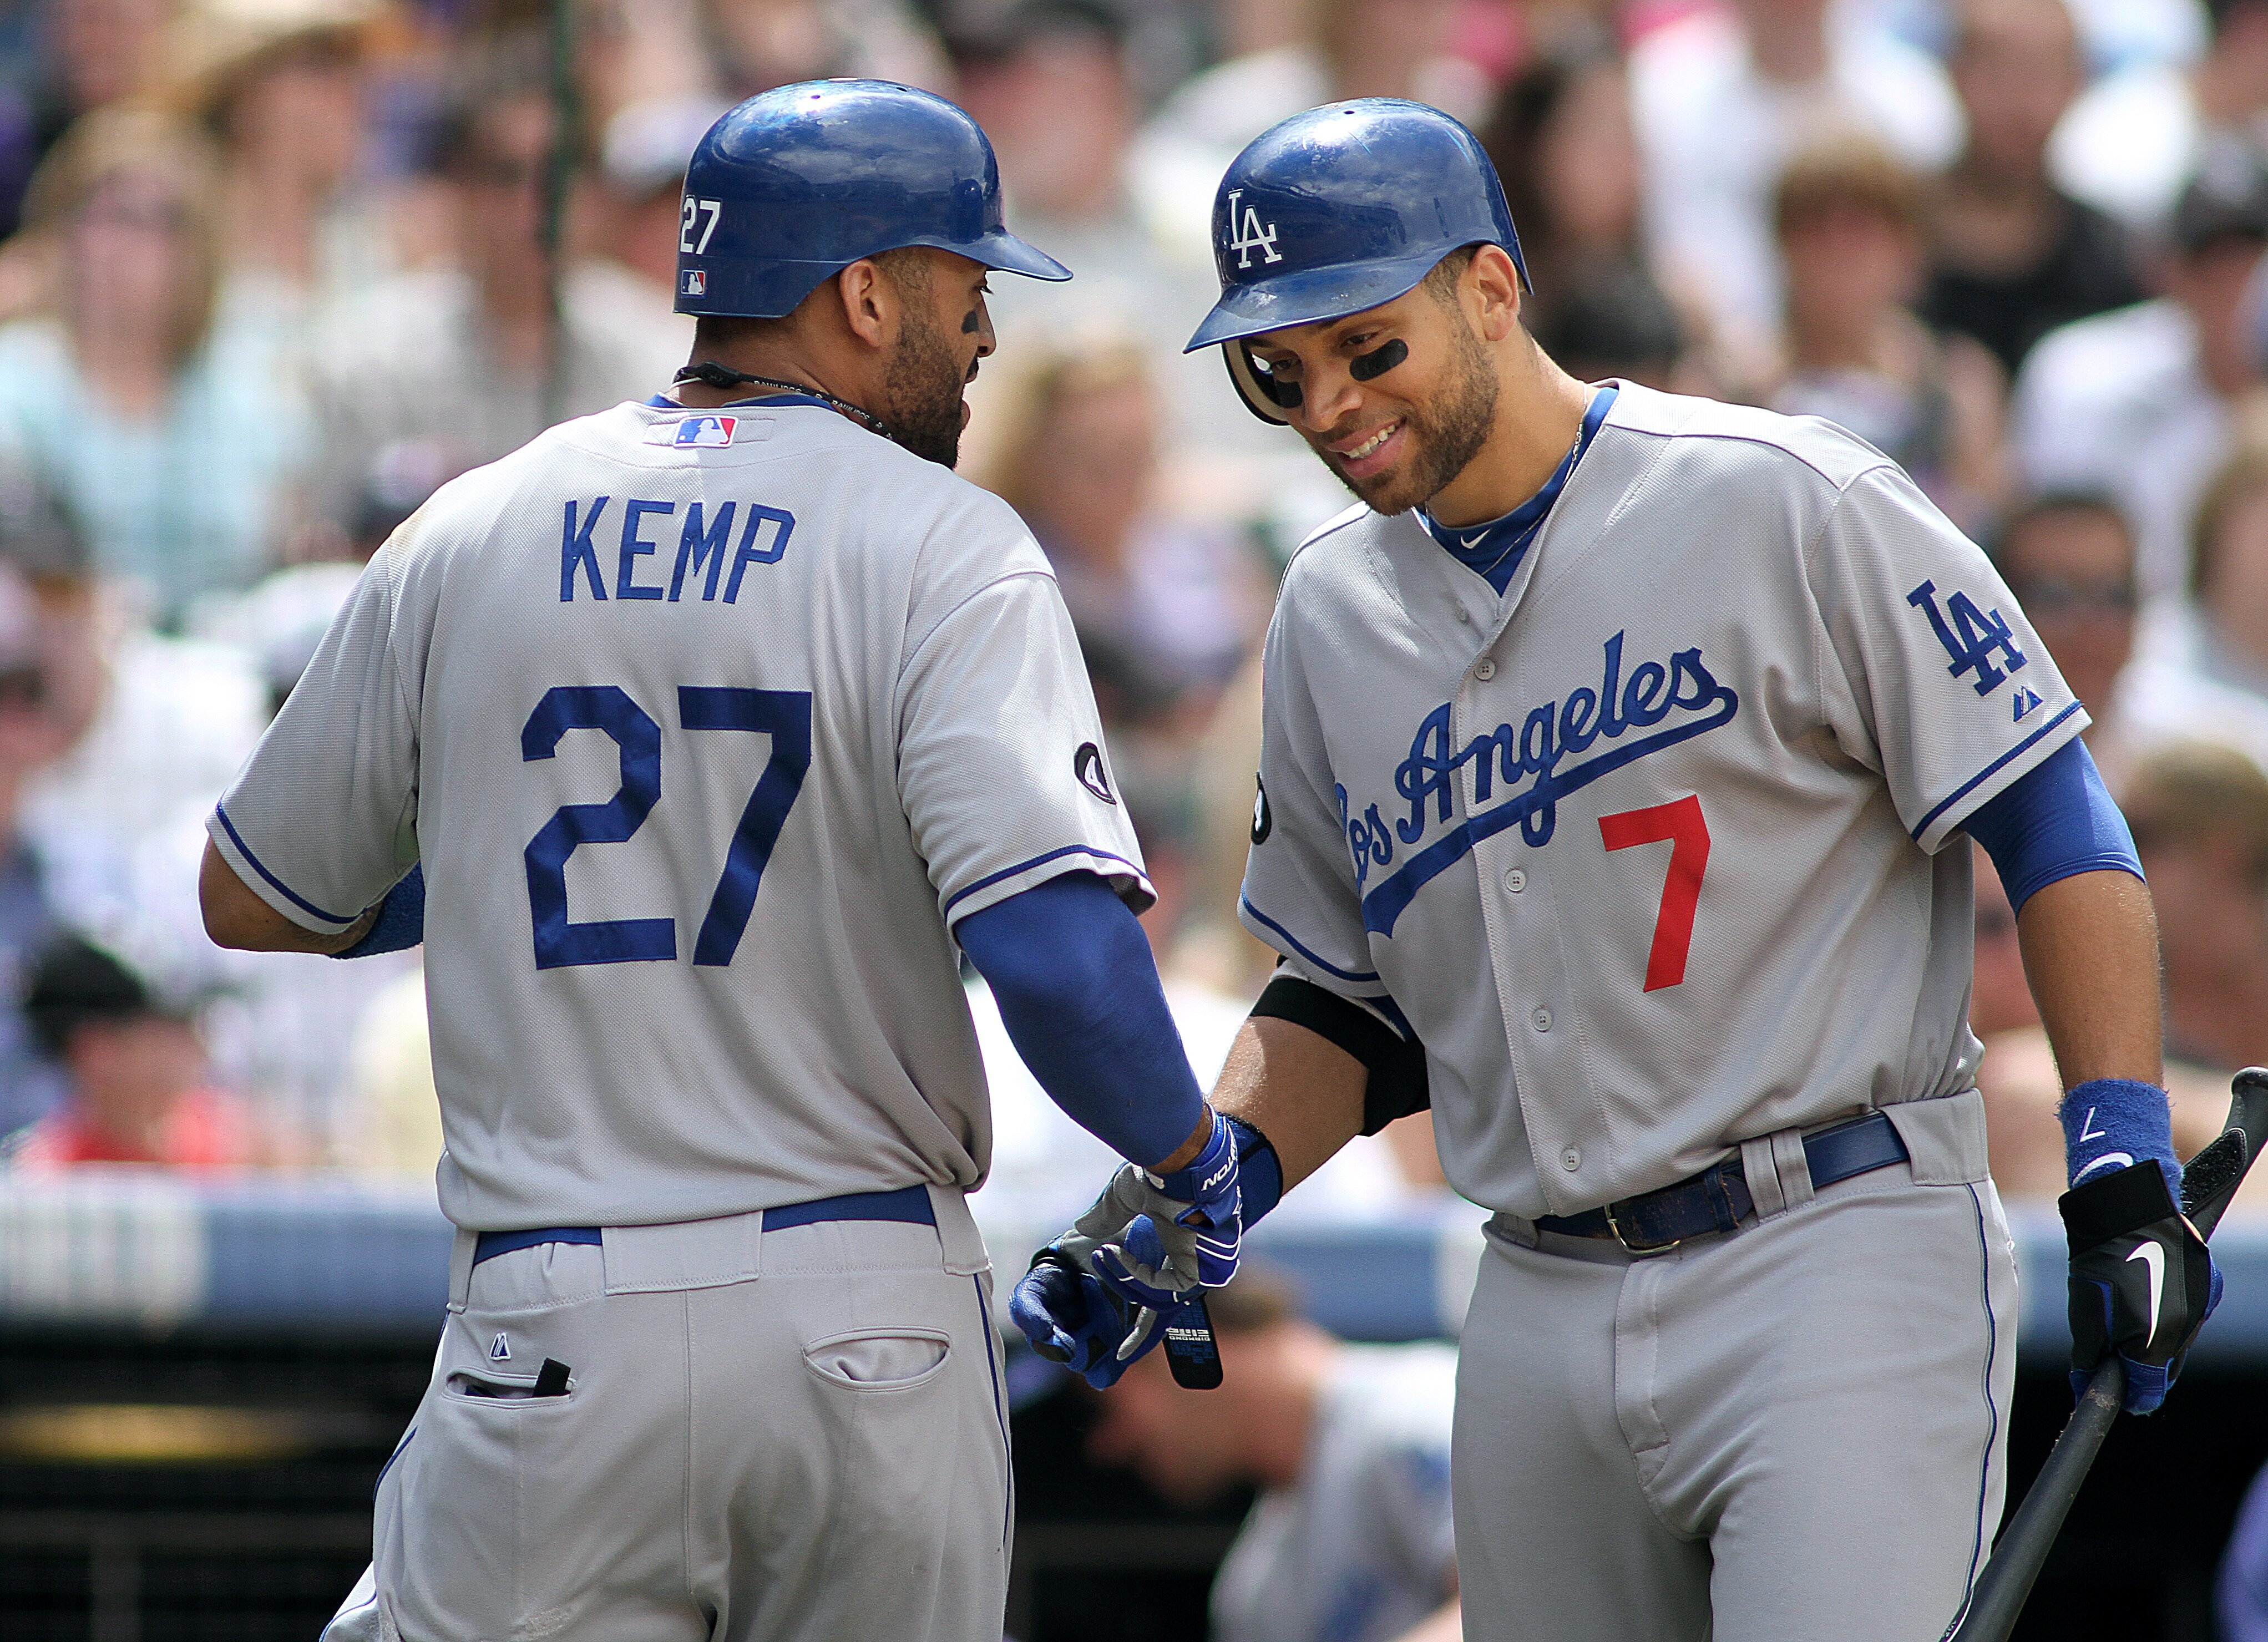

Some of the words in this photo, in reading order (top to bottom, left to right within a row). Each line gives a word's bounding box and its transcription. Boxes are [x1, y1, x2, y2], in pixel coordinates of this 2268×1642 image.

[680, 197, 721, 255] 27
[1228, 190, 1283, 269] LA
[560, 495, 796, 604] KEMP
[1906, 578, 2028, 697] LA
[1394, 629, 1738, 848] Angeles
[520, 685, 812, 971] 27
[1597, 794, 1711, 993] 7
